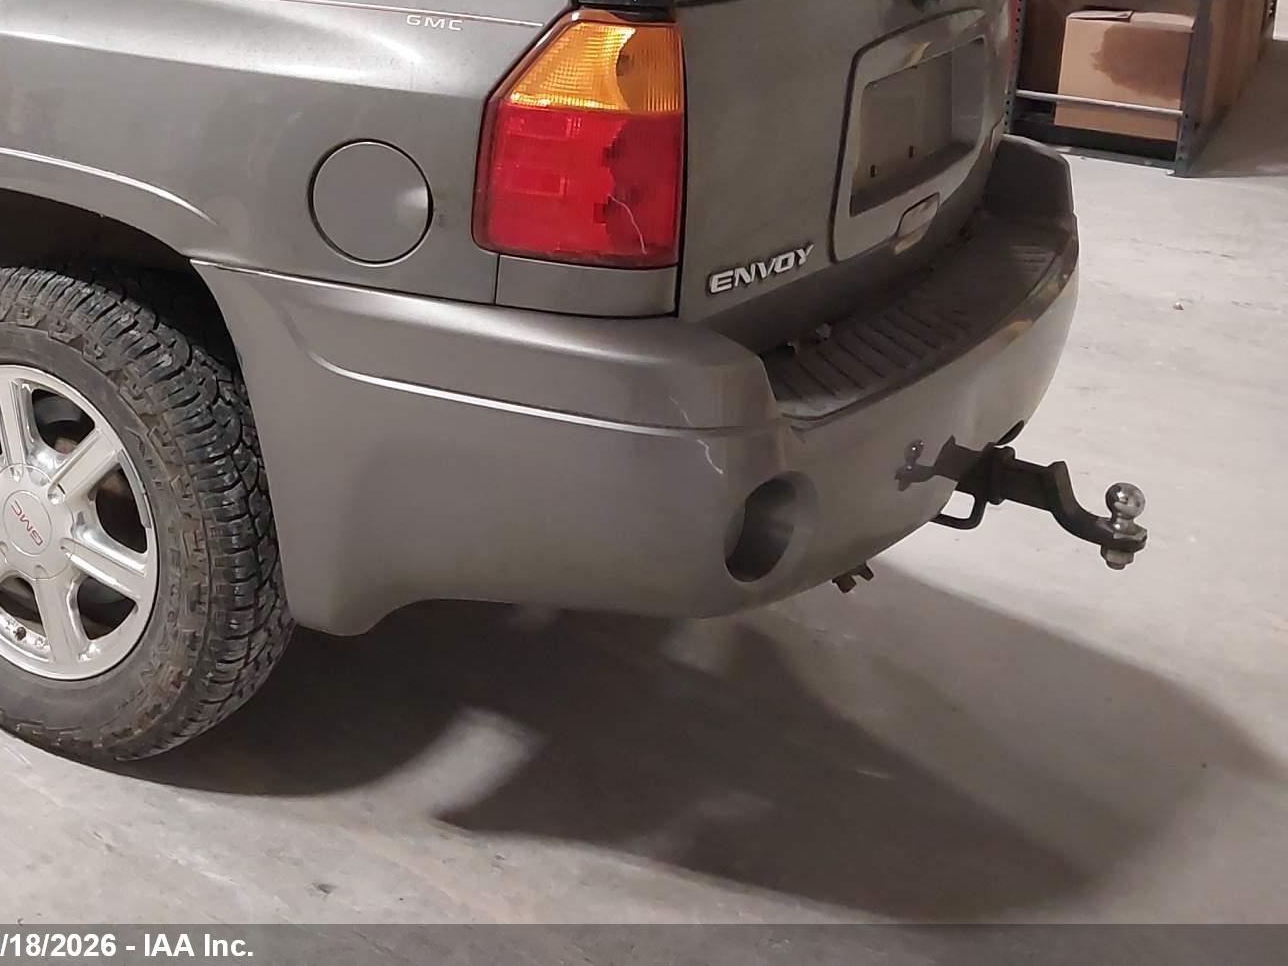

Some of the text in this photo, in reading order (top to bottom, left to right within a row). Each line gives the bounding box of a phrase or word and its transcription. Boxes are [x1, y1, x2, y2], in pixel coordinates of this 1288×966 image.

[406, 14, 463, 31] GMC
[709, 243, 814, 294] ENVOY
[11, 499, 44, 547] GMC
